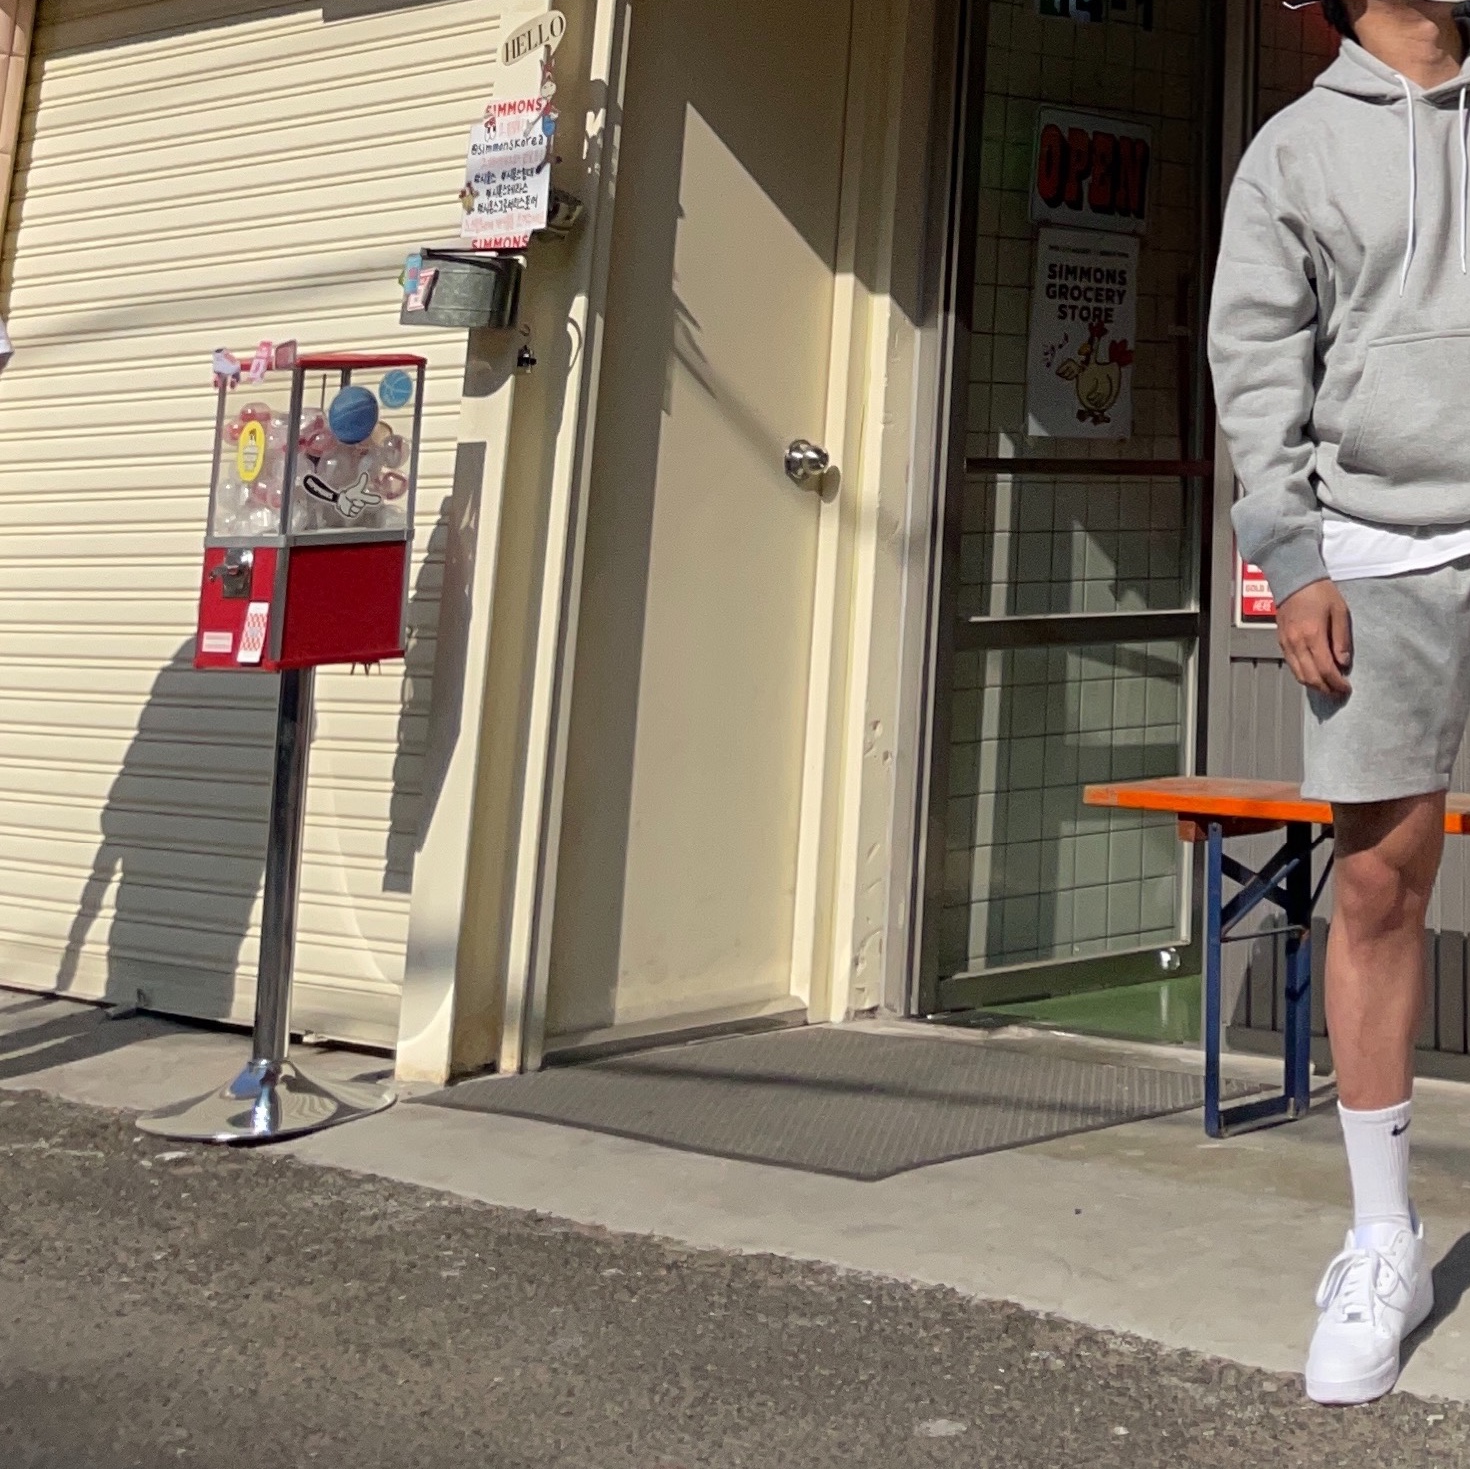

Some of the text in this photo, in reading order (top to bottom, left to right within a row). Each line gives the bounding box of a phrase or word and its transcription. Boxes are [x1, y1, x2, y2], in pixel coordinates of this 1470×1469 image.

[504, 15, 564, 63] HELLO
[485, 97, 543, 117] SIMMONS
[1037, 123, 1150, 220] OPEN
[472, 234, 529, 249] SIMMONS
[1047, 262, 1127, 286] SIMMONS
[1045, 282, 1127, 305] GROCERY
[1057, 303, 1114, 324] STORE
